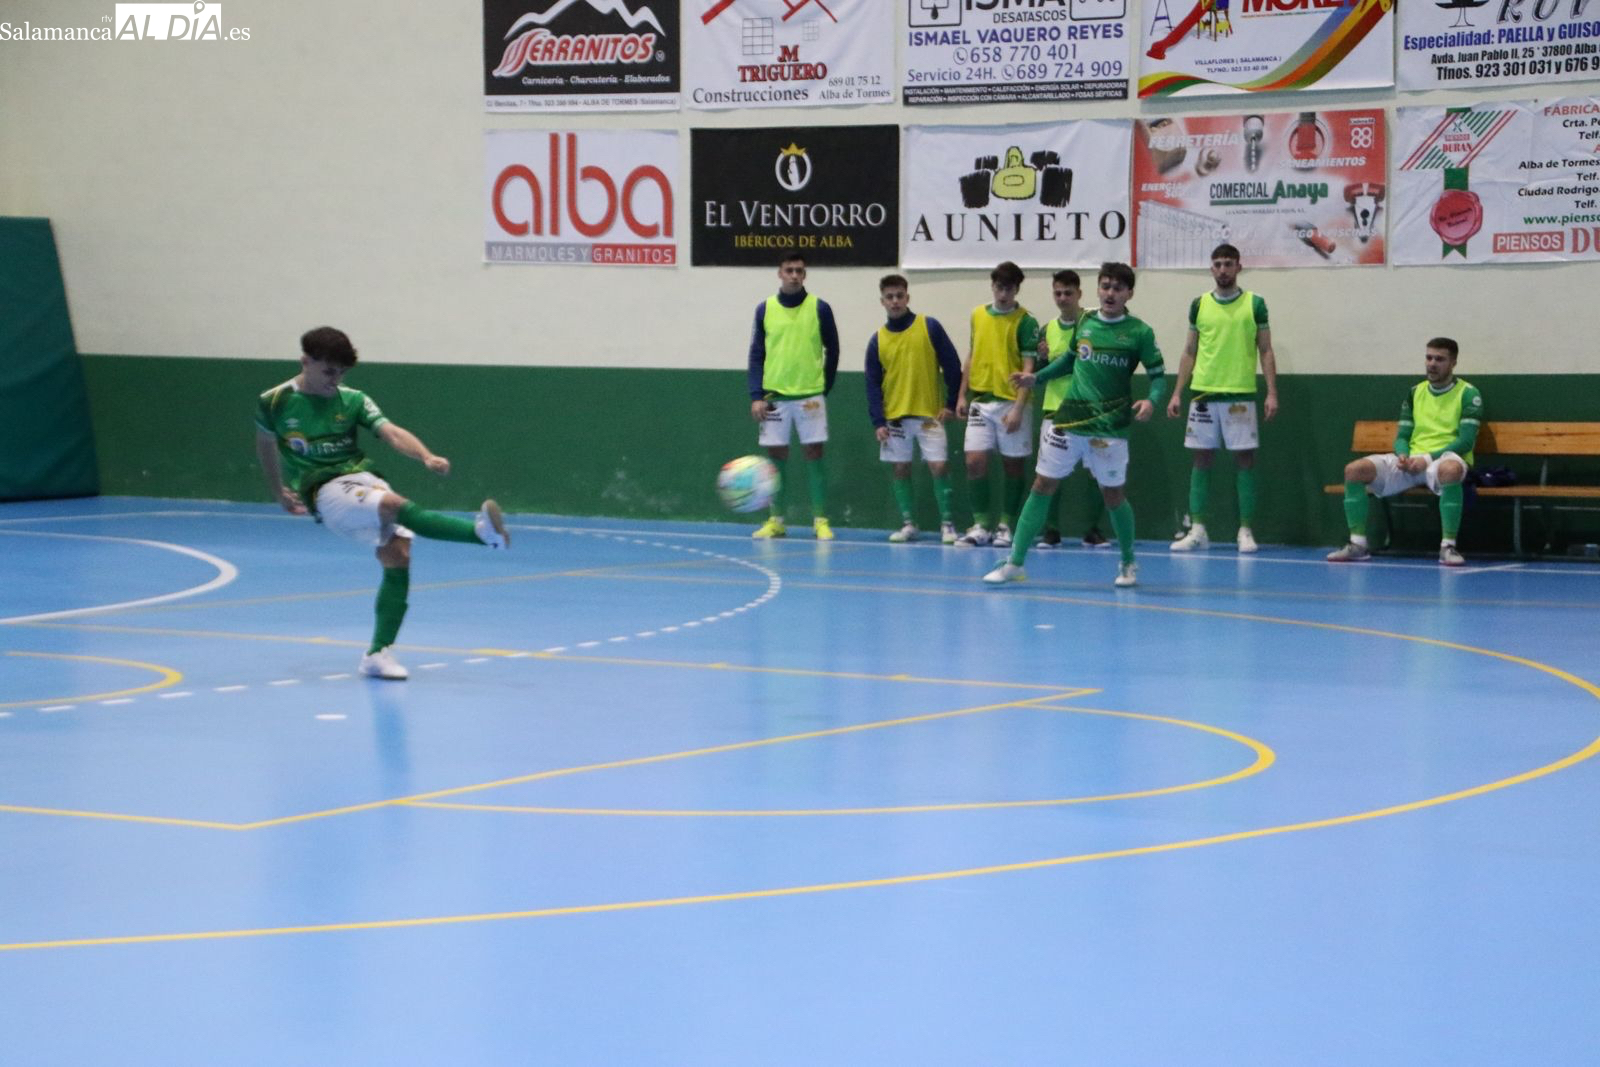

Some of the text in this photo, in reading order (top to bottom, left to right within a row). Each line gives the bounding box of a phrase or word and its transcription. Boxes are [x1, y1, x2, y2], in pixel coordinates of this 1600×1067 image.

[993, 9, 1067, 24] DESATASCOS
[908, 23, 1124, 46] ISMAEL VAQUERO REYES
[1404, 30, 1495, 51] Especialidad:
[1498, 25, 1544, 44] PAELLA
[492, 28, 657, 77] SERRANITOS
[970, 43, 1077, 63] 658 770 401
[1457, 51, 1479, 63] Juan
[1481, 49, 1509, 61] Pablo
[1522, 47, 1535, 59] 25
[1542, 45, 1572, 57] 37800
[1574, 43, 1597, 55] Alba
[623, 74, 671, 83] Elaborados
[737, 62, 828, 83] TRIGUERO
[908, 60, 1123, 82] Servicio 24H. 689 724 909
[1437, 65, 1473, 81] Tfnos.
[1475, 63, 1500, 78] 923
[1503, 62, 1526, 77] 301
[1529, 60, 1552, 75] 031
[1564, 58, 1588, 72] 676
[857, 76, 869, 86] 75
[871, 75, 881, 85] 12
[692, 87, 810, 105] Construcciones
[818, 88, 891, 100] Alba de Tormes
[1562, 118, 1588, 128] Crta.
[1518, 160, 1544, 170] Alba
[1545, 159, 1559, 169] de
[492, 132, 674, 239] alba
[1576, 172, 1600, 182] Telf.
[1210, 182, 1269, 199] COMERCIAL
[1272, 180, 1329, 204] Anaya
[1517, 186, 1555, 197] Ciudad
[705, 200, 887, 227] EL VENTORRO
[1574, 200, 1598, 209] Telf.
[911, 211, 1126, 241] AUNIETO
[735, 232, 853, 248] IBÉRICOS DE ALBA
[1496, 234, 1562, 250] PIENSOS
[580, 247, 588, 261] Y
[593, 247, 673, 263] GRANITOS
